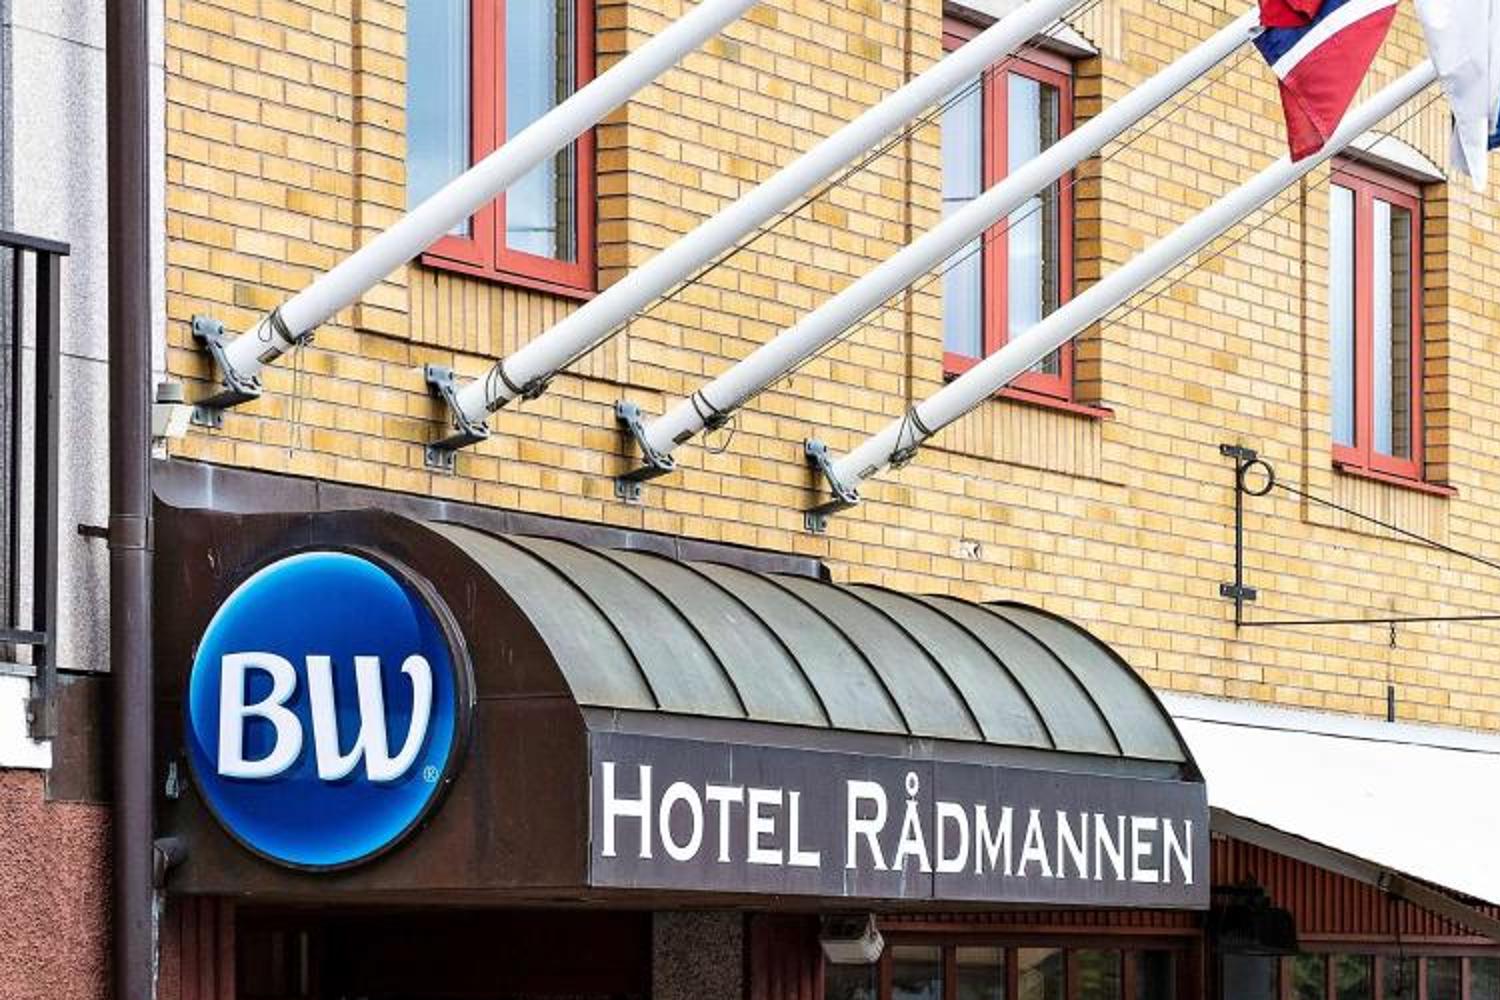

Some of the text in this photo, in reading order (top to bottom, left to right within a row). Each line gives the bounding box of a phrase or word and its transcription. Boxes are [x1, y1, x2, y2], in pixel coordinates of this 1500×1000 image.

[217, 651, 433, 783] BW
[600, 761, 1195, 886] HOTEL RÅDMANNEN
